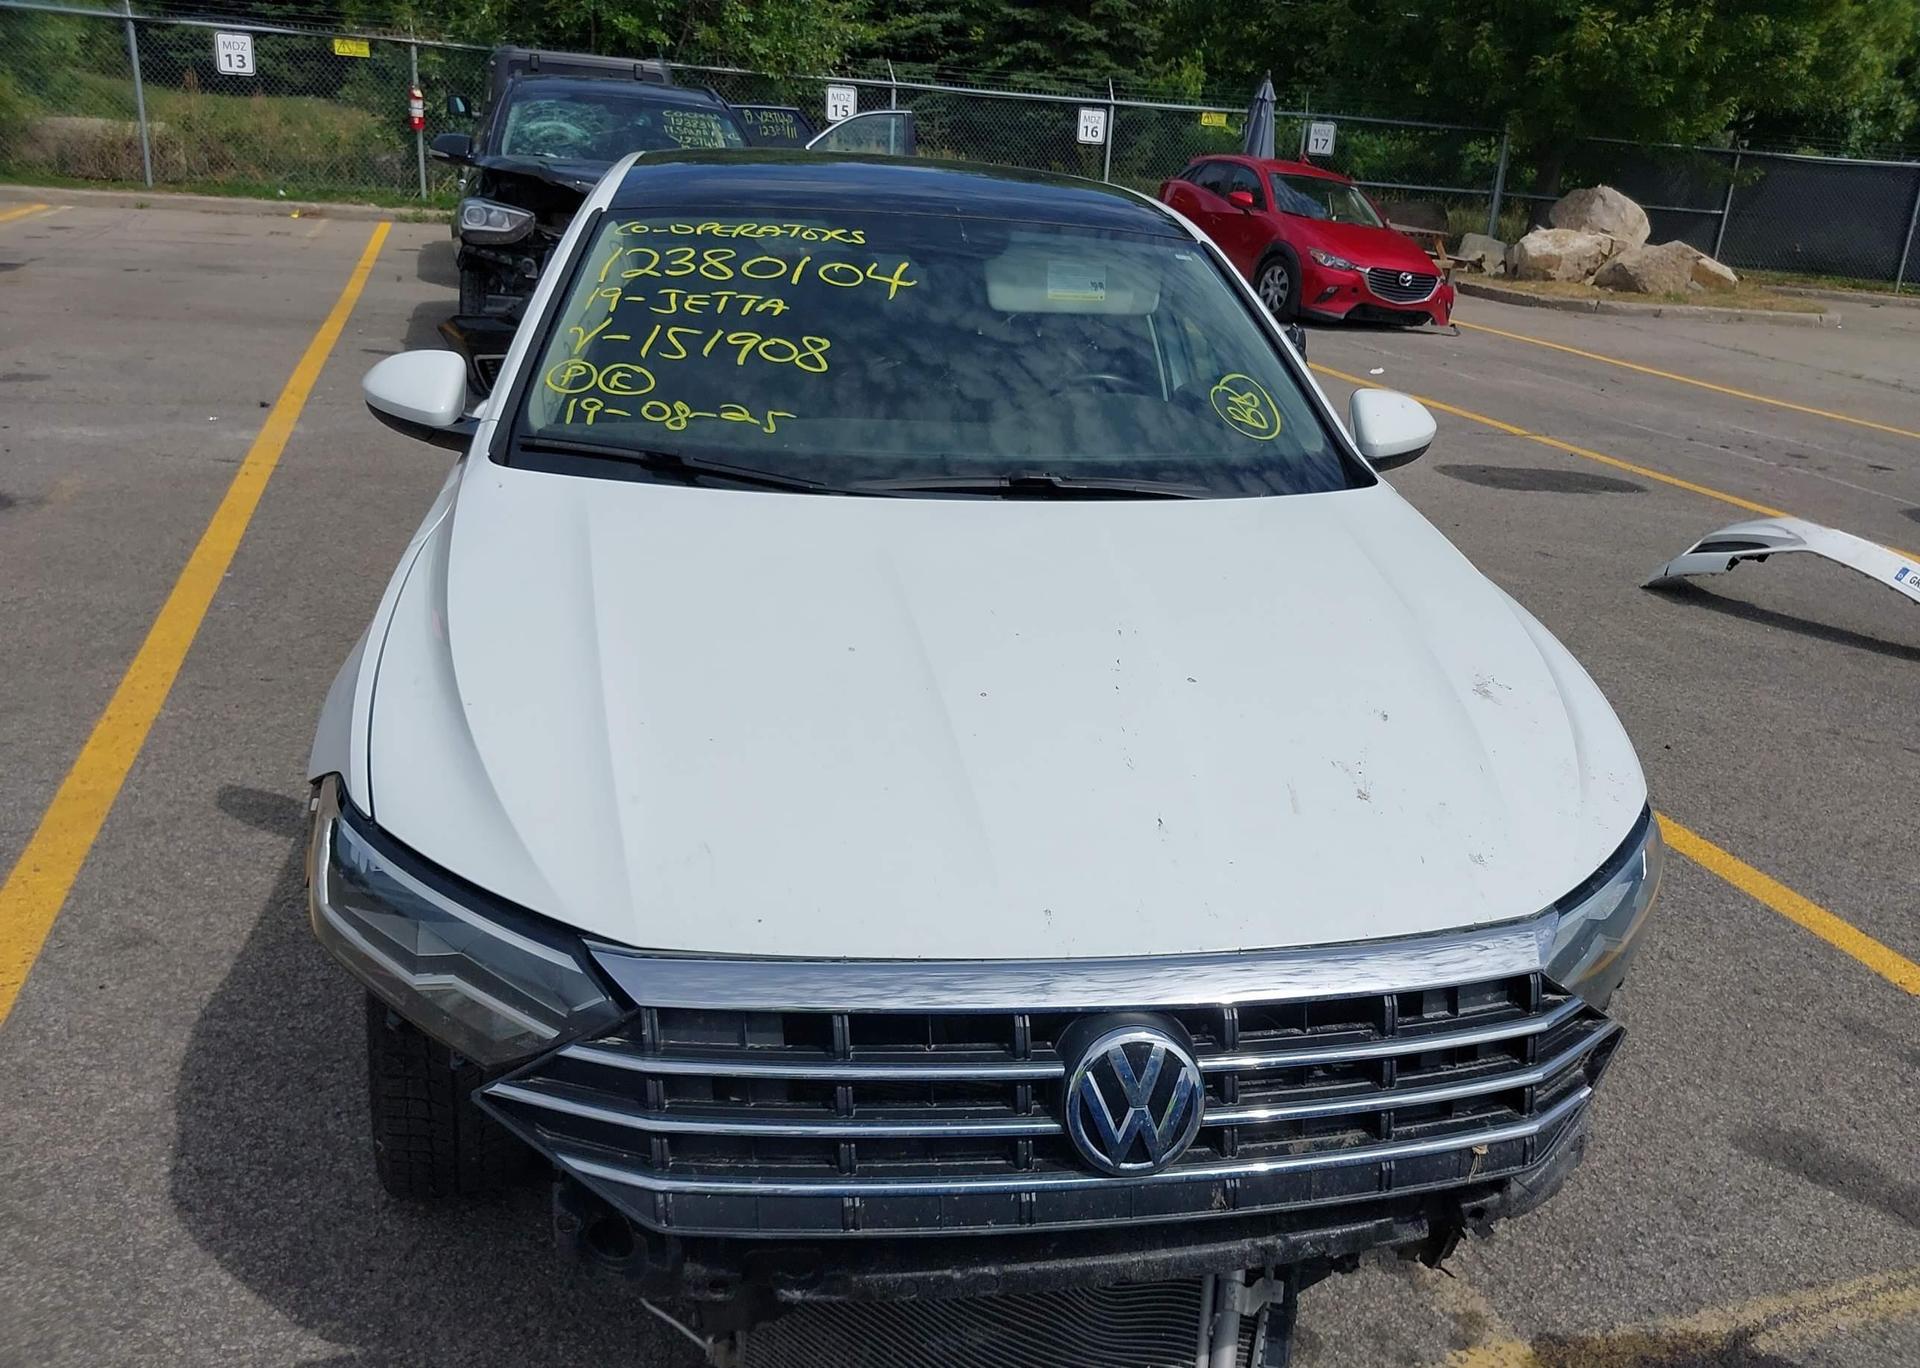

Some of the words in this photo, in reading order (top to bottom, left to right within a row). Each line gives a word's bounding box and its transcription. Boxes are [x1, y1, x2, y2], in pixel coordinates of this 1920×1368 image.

[222, 40, 247, 52] MDZ
[225, 53, 247, 69] 13
[831, 93, 851, 103] MDZ
[832, 104, 849, 118] 15
[1083, 114, 1102, 125] MDZ
[1083, 125, 1099, 138] 16
[1313, 138, 1329, 150] 17
[599, 247, 918, 300] 12380104
[569, 318, 831, 372] V-151908
[566, 397, 798, 434] 19-08-25
